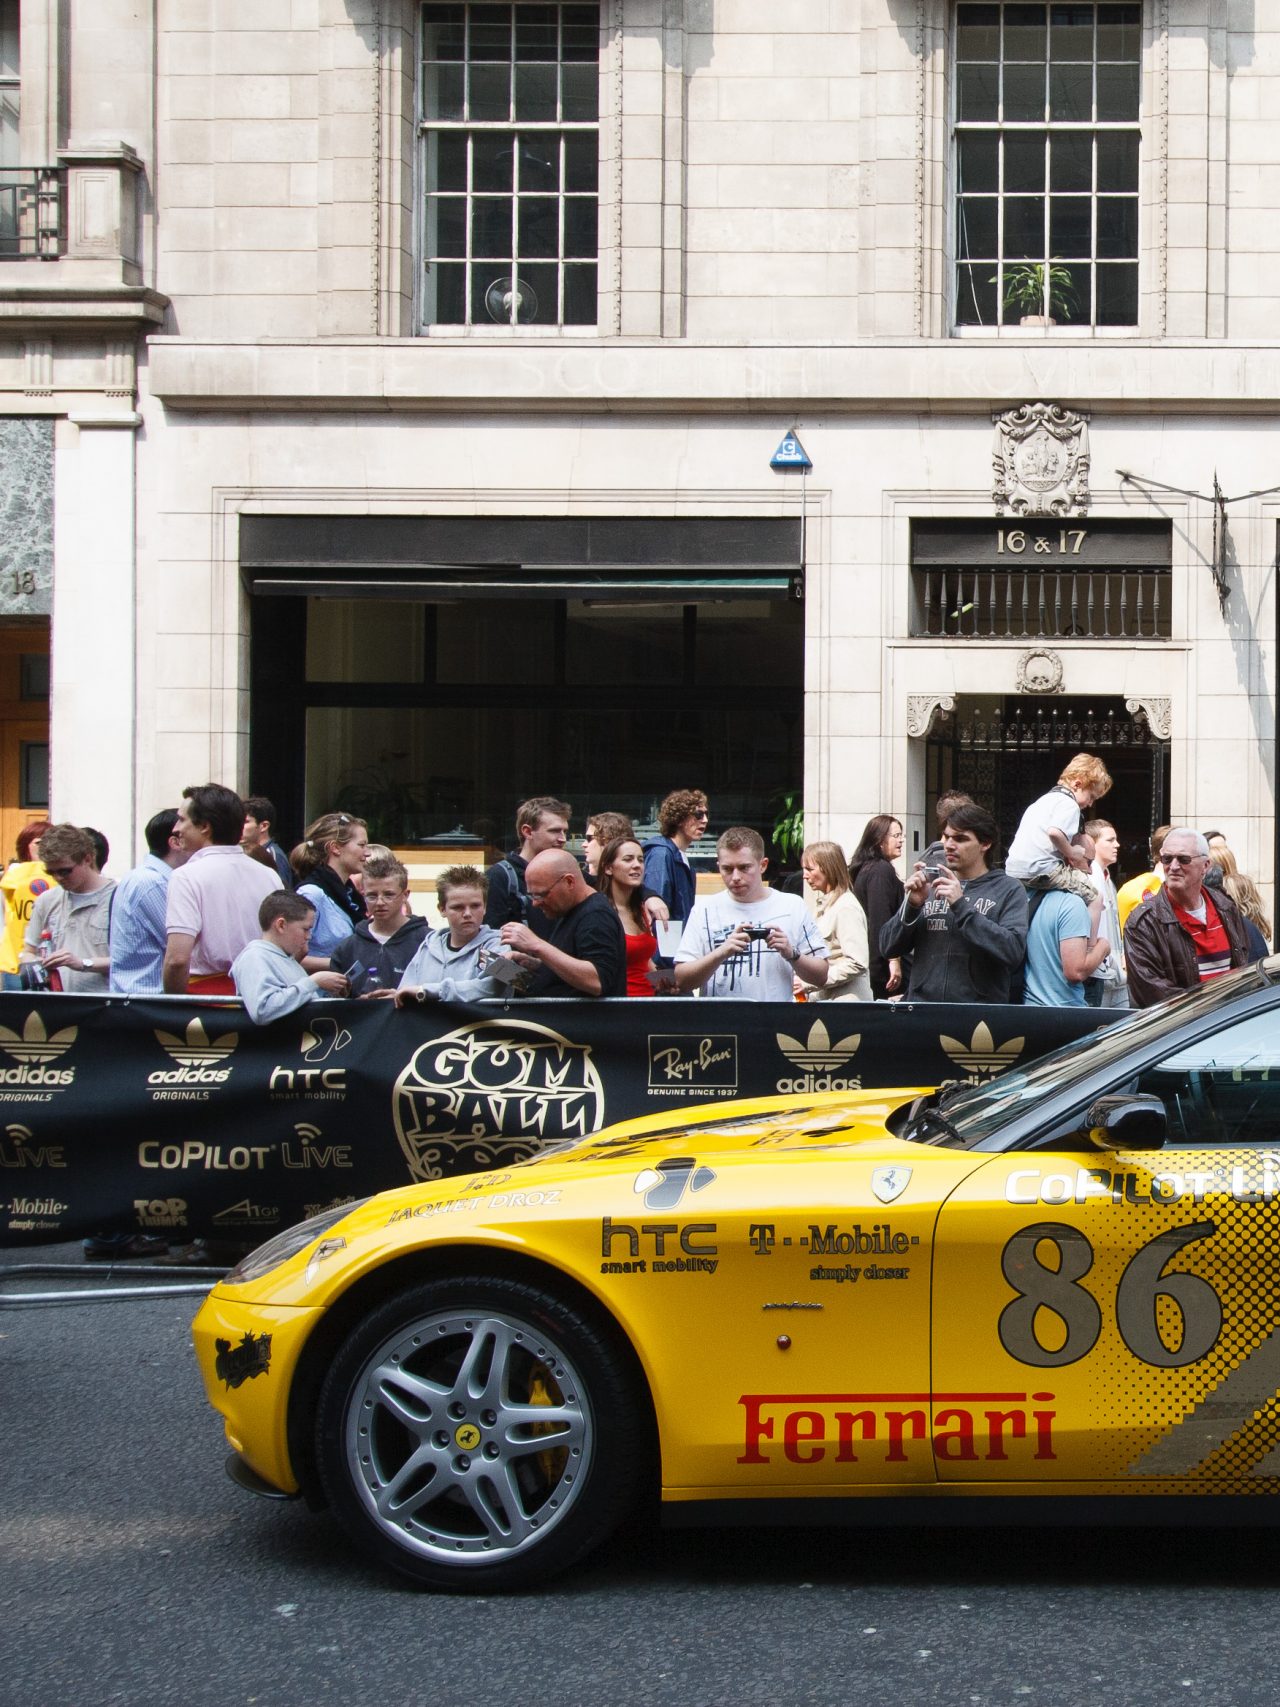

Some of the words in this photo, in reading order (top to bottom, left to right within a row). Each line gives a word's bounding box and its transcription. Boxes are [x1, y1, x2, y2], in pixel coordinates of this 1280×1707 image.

[997, 530, 1026, 554] 16
[1034, 536, 1051, 553] &
[1059, 530, 1087, 554] 17
[11, 570, 36, 595] 18
[147, 1066, 230, 1085] adidas
[776, 1074, 862, 1094] adidas
[152, 1091, 210, 1101] ORIGINALS
[304, 1090, 347, 1102] mobility
[647, 1088, 686, 1097] GENUINE
[688, 1088, 715, 1097] SINCE
[717, 1088, 738, 1096] 1937
[133, 1197, 188, 1217] TOP
[384, 1195, 486, 1228] JAQUET
[487, 1189, 563, 1210] DROZ
[8, 1219, 36, 1231] simply
[135, 1215, 188, 1227] TRUMPS
[600, 1259, 647, 1274] smart
[652, 1256, 720, 1274] mobility
[810, 1264, 862, 1284] simply
[863, 1264, 909, 1280] closer
[997, 1221, 1223, 1369] 86
[737, 1391, 1058, 1465] Ferrari
